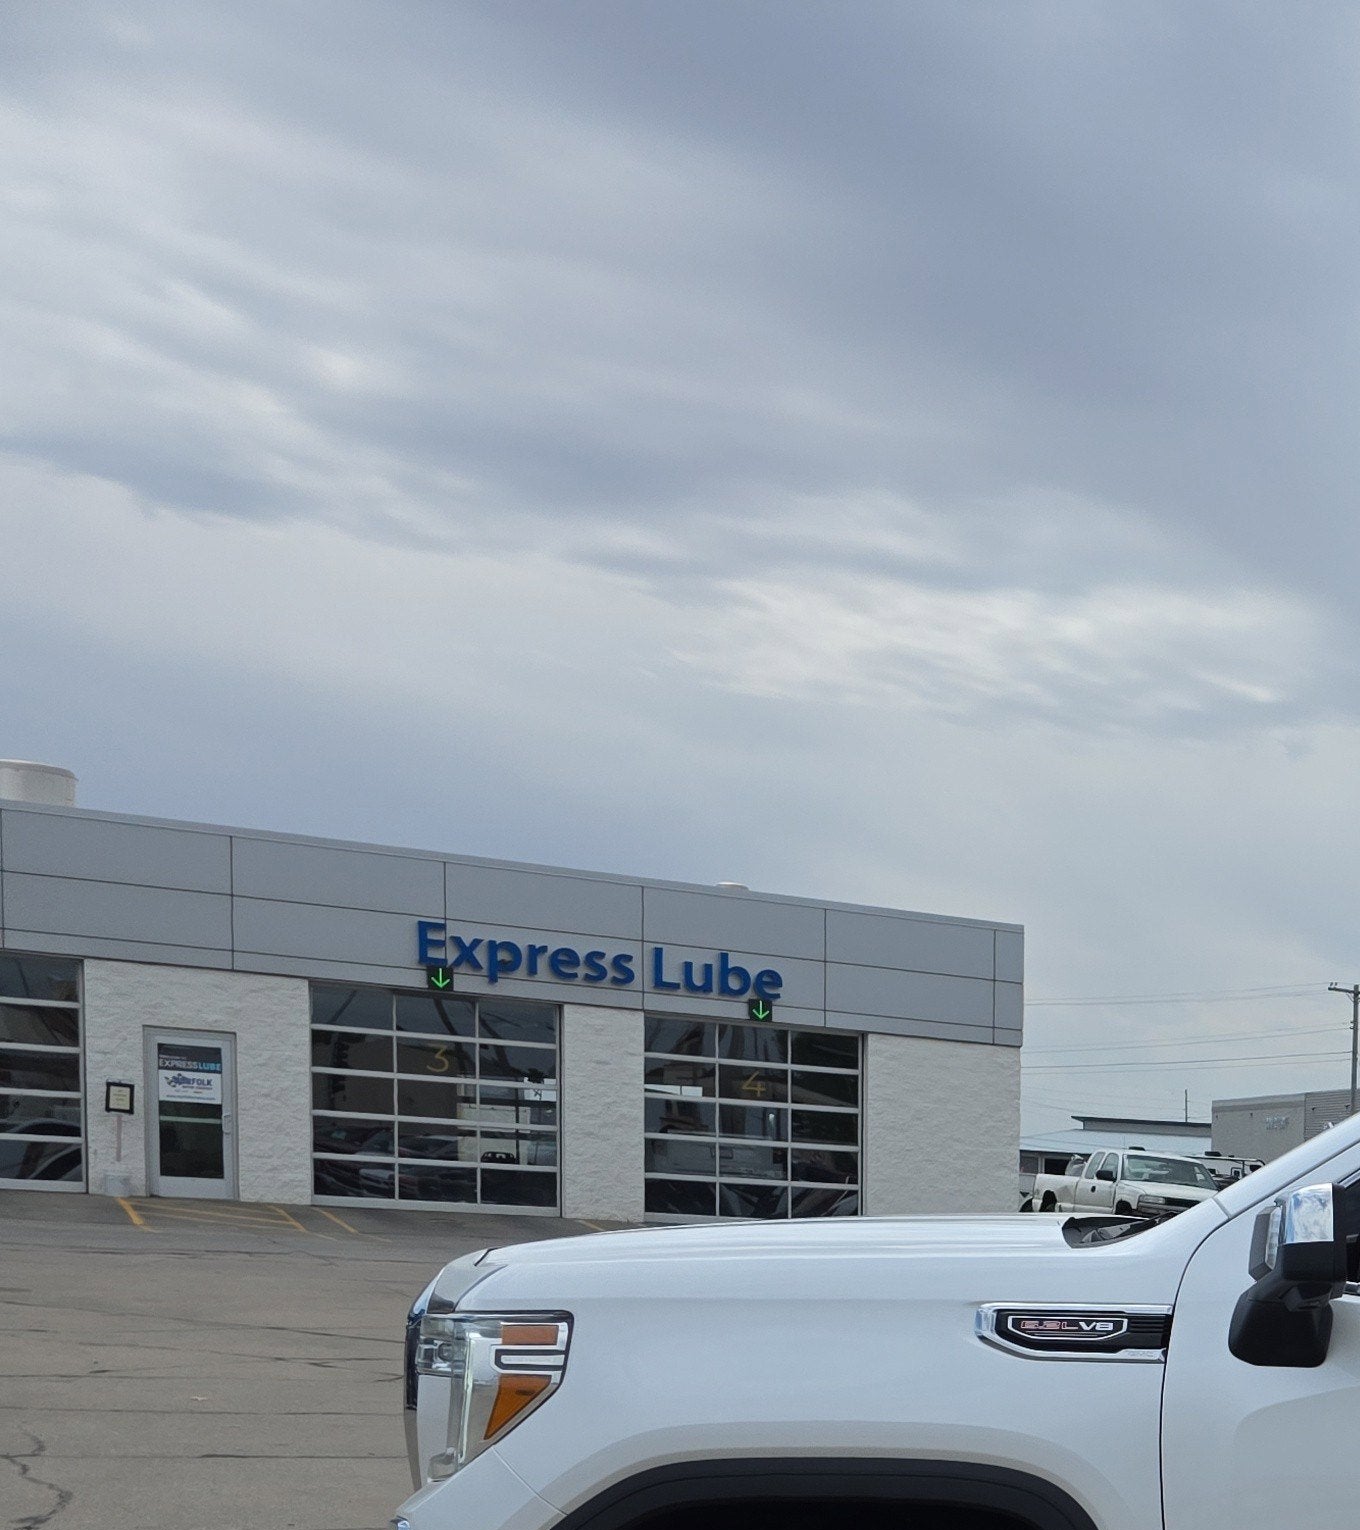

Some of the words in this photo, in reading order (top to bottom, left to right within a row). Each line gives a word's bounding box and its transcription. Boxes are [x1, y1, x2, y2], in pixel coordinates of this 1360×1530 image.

[417, 920, 635, 984] Express
[652, 947, 784, 1000] Lube
[426, 1045, 449, 1072] 3
[742, 1071, 766, 1097] 4
